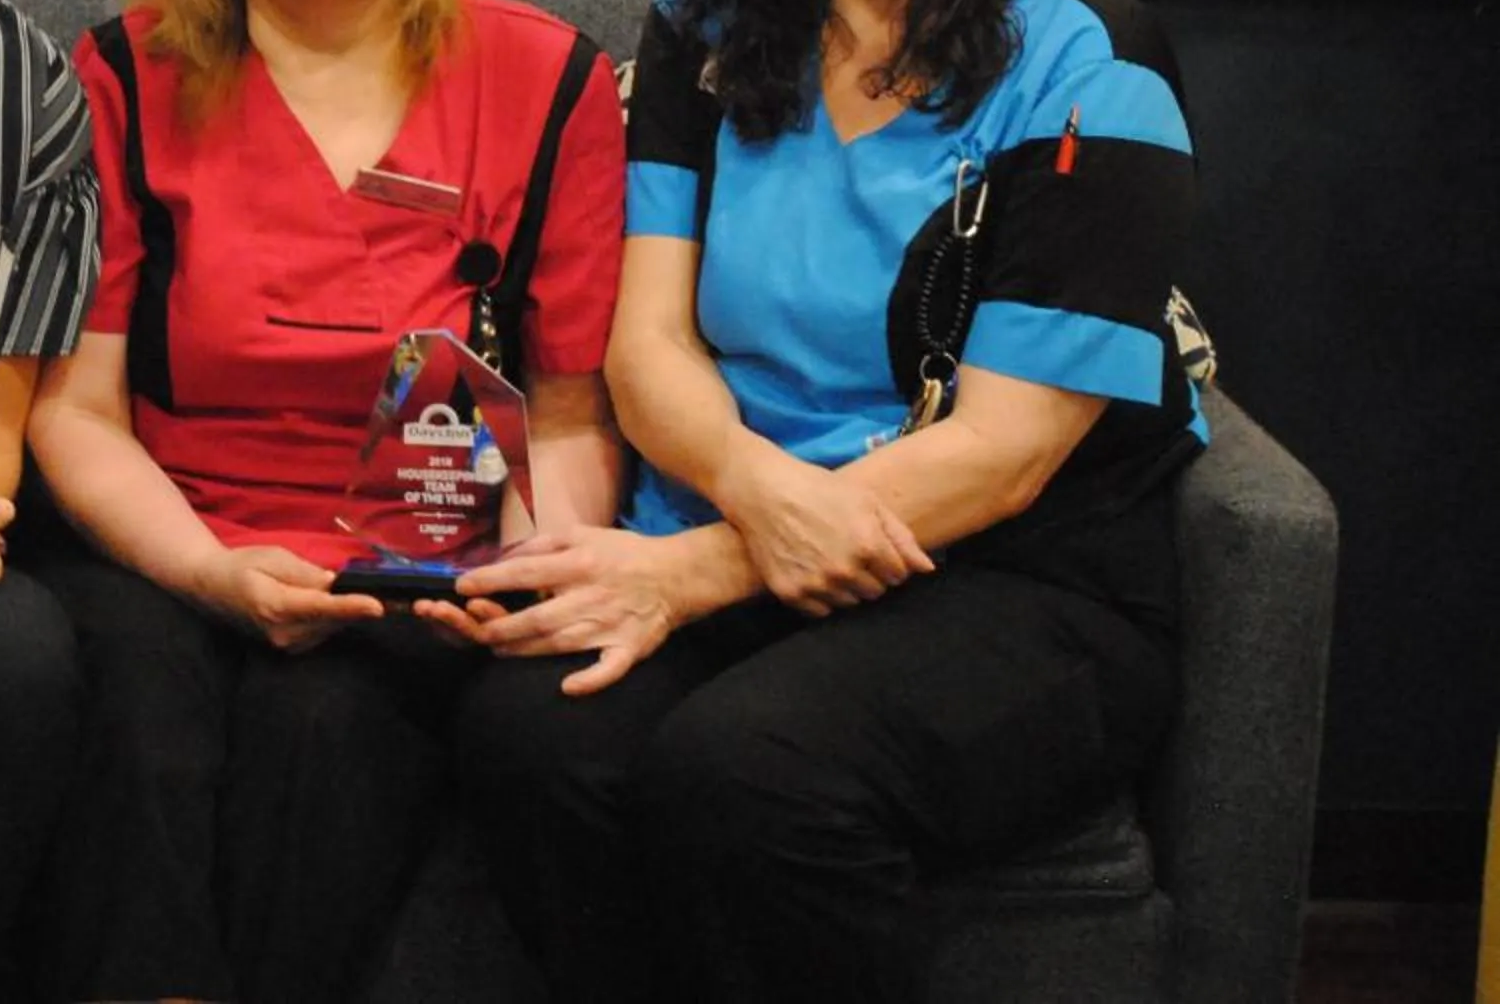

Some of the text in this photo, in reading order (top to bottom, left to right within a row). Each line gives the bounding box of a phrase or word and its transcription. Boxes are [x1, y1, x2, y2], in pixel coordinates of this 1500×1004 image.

[397, 467, 481, 483] HOUSEKEEPIN
[423, 480, 457, 493] TEAM
[403, 491, 476, 507] OF THE YEAR
